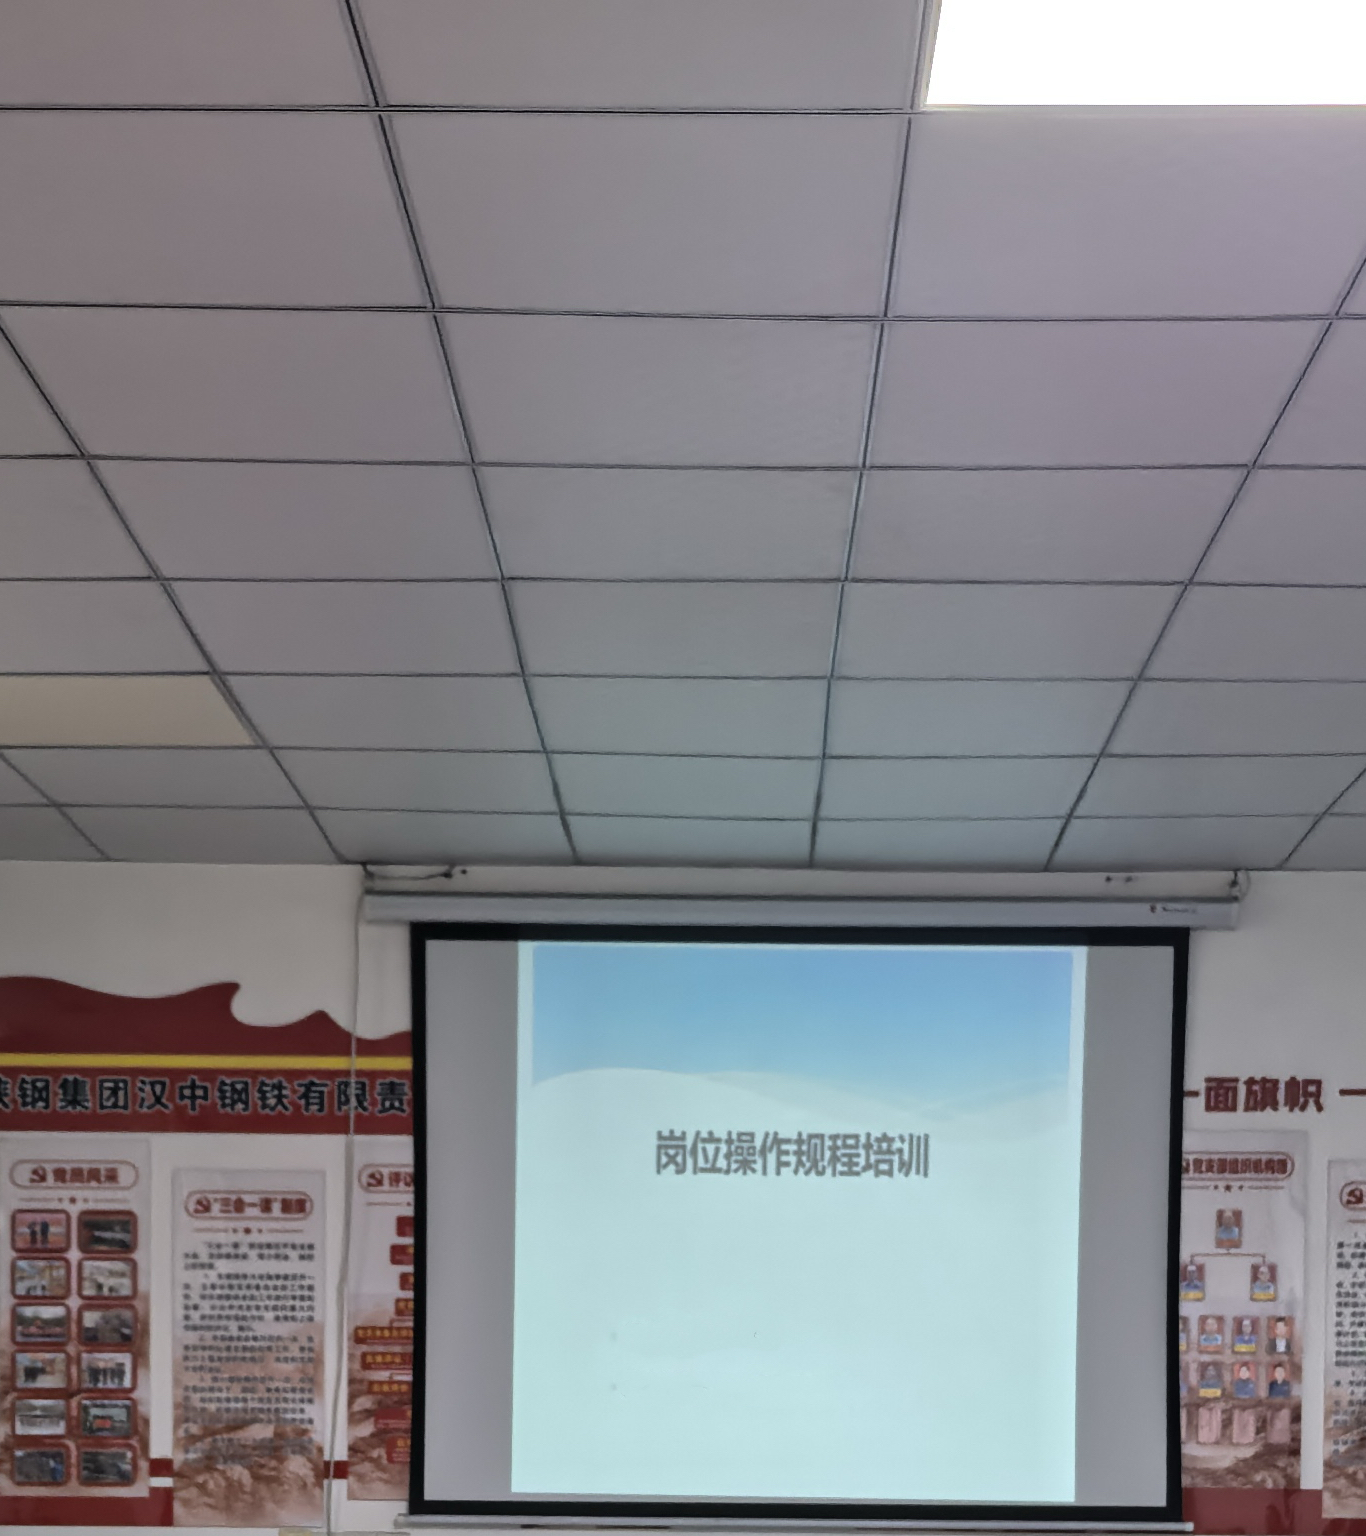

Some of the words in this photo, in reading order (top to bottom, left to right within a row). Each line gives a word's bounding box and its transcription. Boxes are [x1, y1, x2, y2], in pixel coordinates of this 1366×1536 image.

[655, 1130, 930, 1178] 岗位操作规程培训
